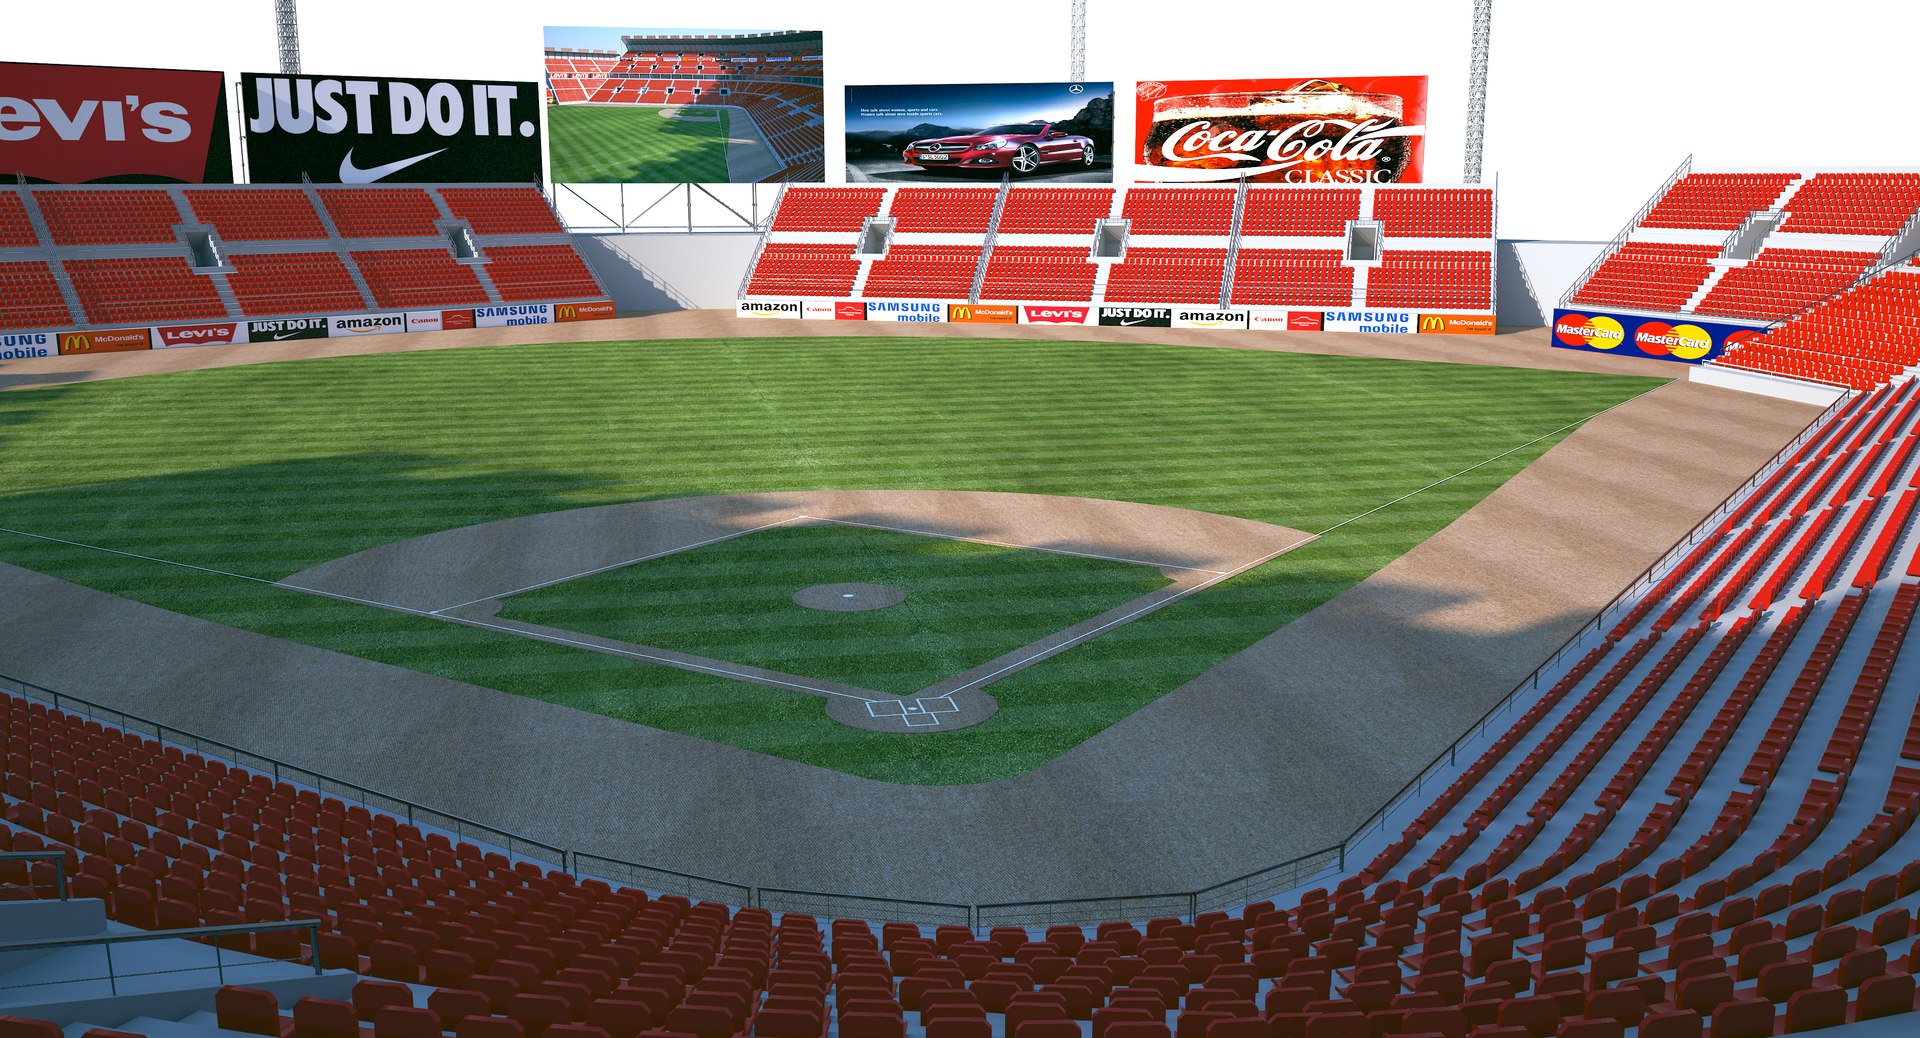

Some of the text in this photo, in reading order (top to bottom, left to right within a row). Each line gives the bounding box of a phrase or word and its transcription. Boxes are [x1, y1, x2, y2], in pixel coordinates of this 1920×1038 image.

[250, 77, 535, 138] JUST DO IT.
[1161, 118, 1395, 164] Coca-Cola
[1284, 169, 1392, 184] CLASSIC
[477, 304, 548, 318] SAMSUNG
[742, 301, 798, 312] amazon
[868, 302, 940, 312] SAMSUNG
[898, 313, 940, 322] mobile
[1101, 308, 1170, 319] JUST DO IT.
[1179, 310, 1244, 322] amazon
[1326, 312, 1409, 322] SAMSUNG
[252, 318, 328, 332] JUST DO IT.
[336, 316, 401, 329] amazon
[506, 315, 548, 326] mobile
[1449, 319, 1493, 327] McDonald's
[1360, 324, 1408, 334] mobile
[94, 334, 144, 343] McDonald's
[1556, 324, 1622, 340] MasterCard
[1636, 332, 1710, 349] MasterCard
